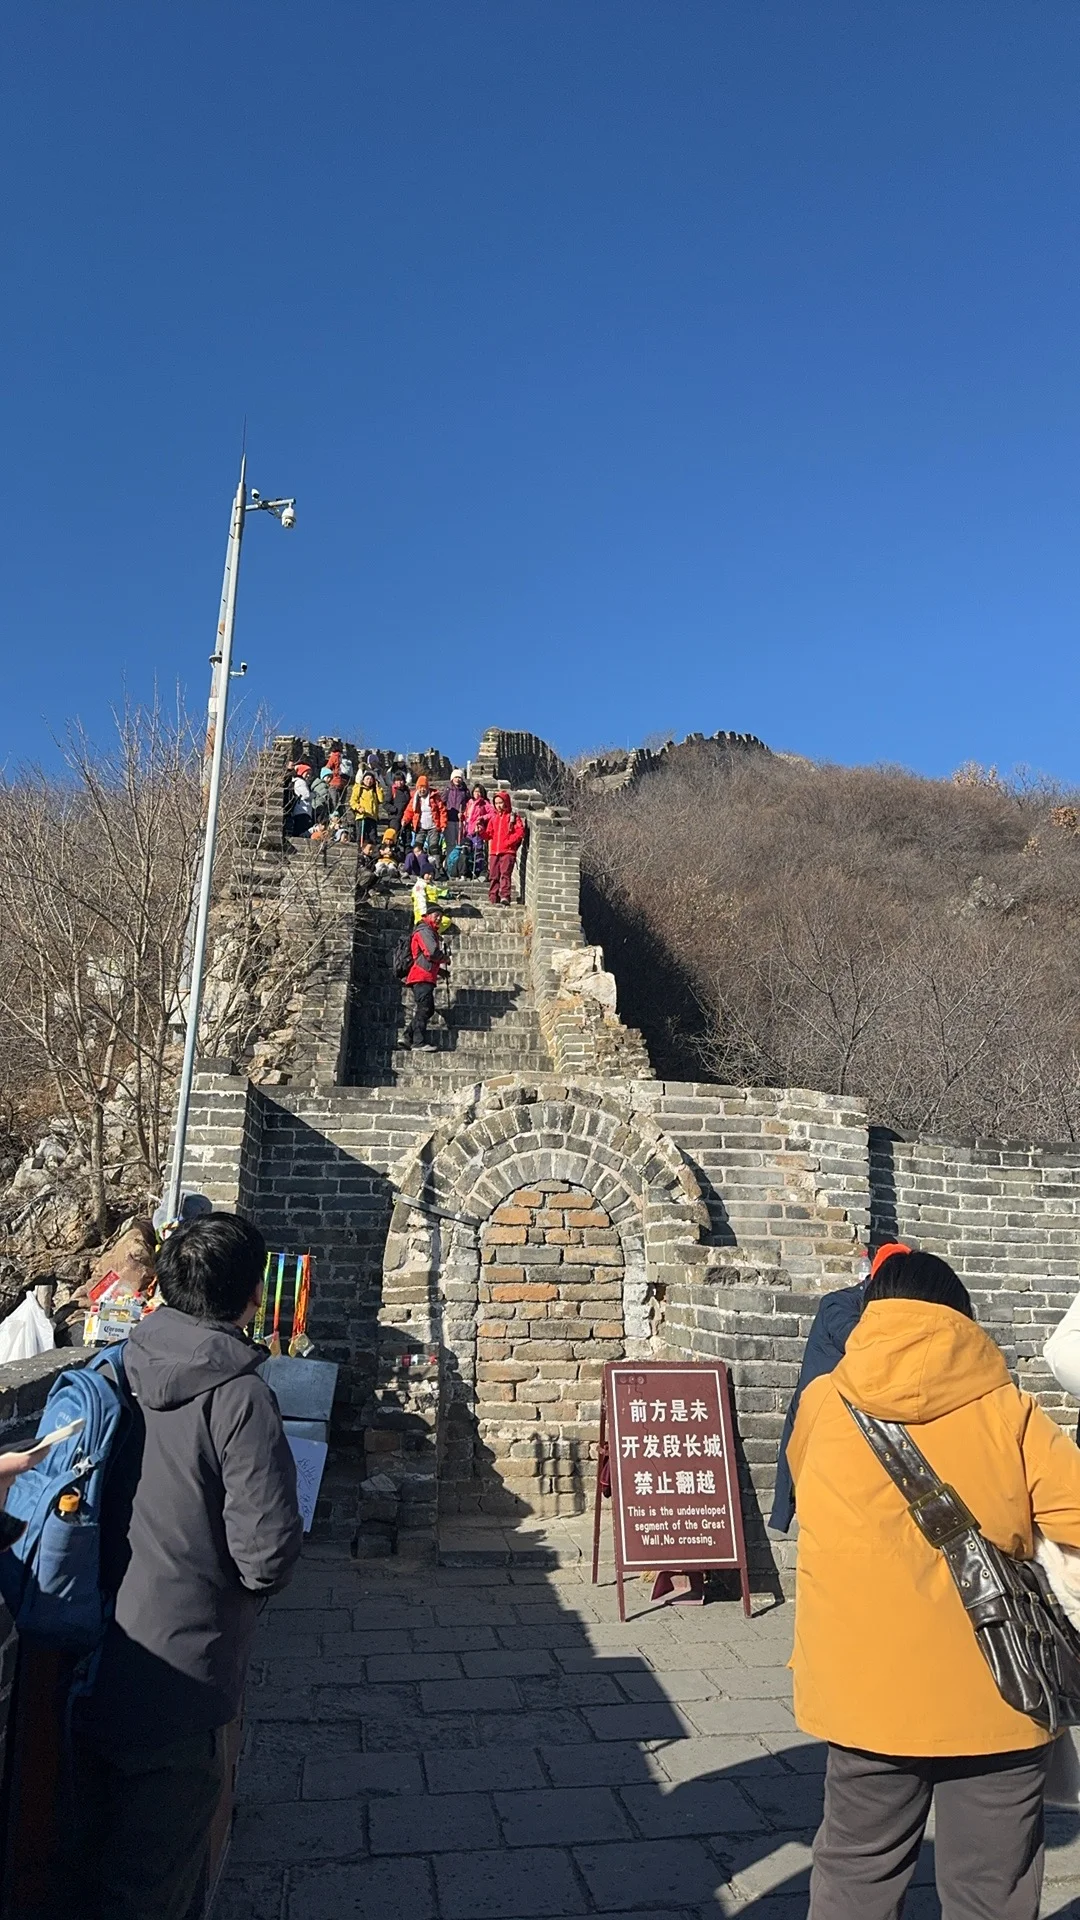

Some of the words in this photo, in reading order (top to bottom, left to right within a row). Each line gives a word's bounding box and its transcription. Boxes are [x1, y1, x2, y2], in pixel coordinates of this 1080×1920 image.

[629, 1399, 708, 1422] 前方是未
[621, 1434, 722, 1458] 开发段长城
[634, 1470, 716, 1495] 禁止翻越
[627, 1506, 645, 1517] This
[649, 1506, 656, 1516] is
[660, 1506, 673, 1516] the
[677, 1504, 726, 1517] undeveloped
[635, 1521, 669, 1533] segment
[672, 1520, 680, 1530] of
[685, 1520, 698, 1530] the
[701, 1519, 725, 1529] Great
[678, 1533, 716, 1546] crossing.
